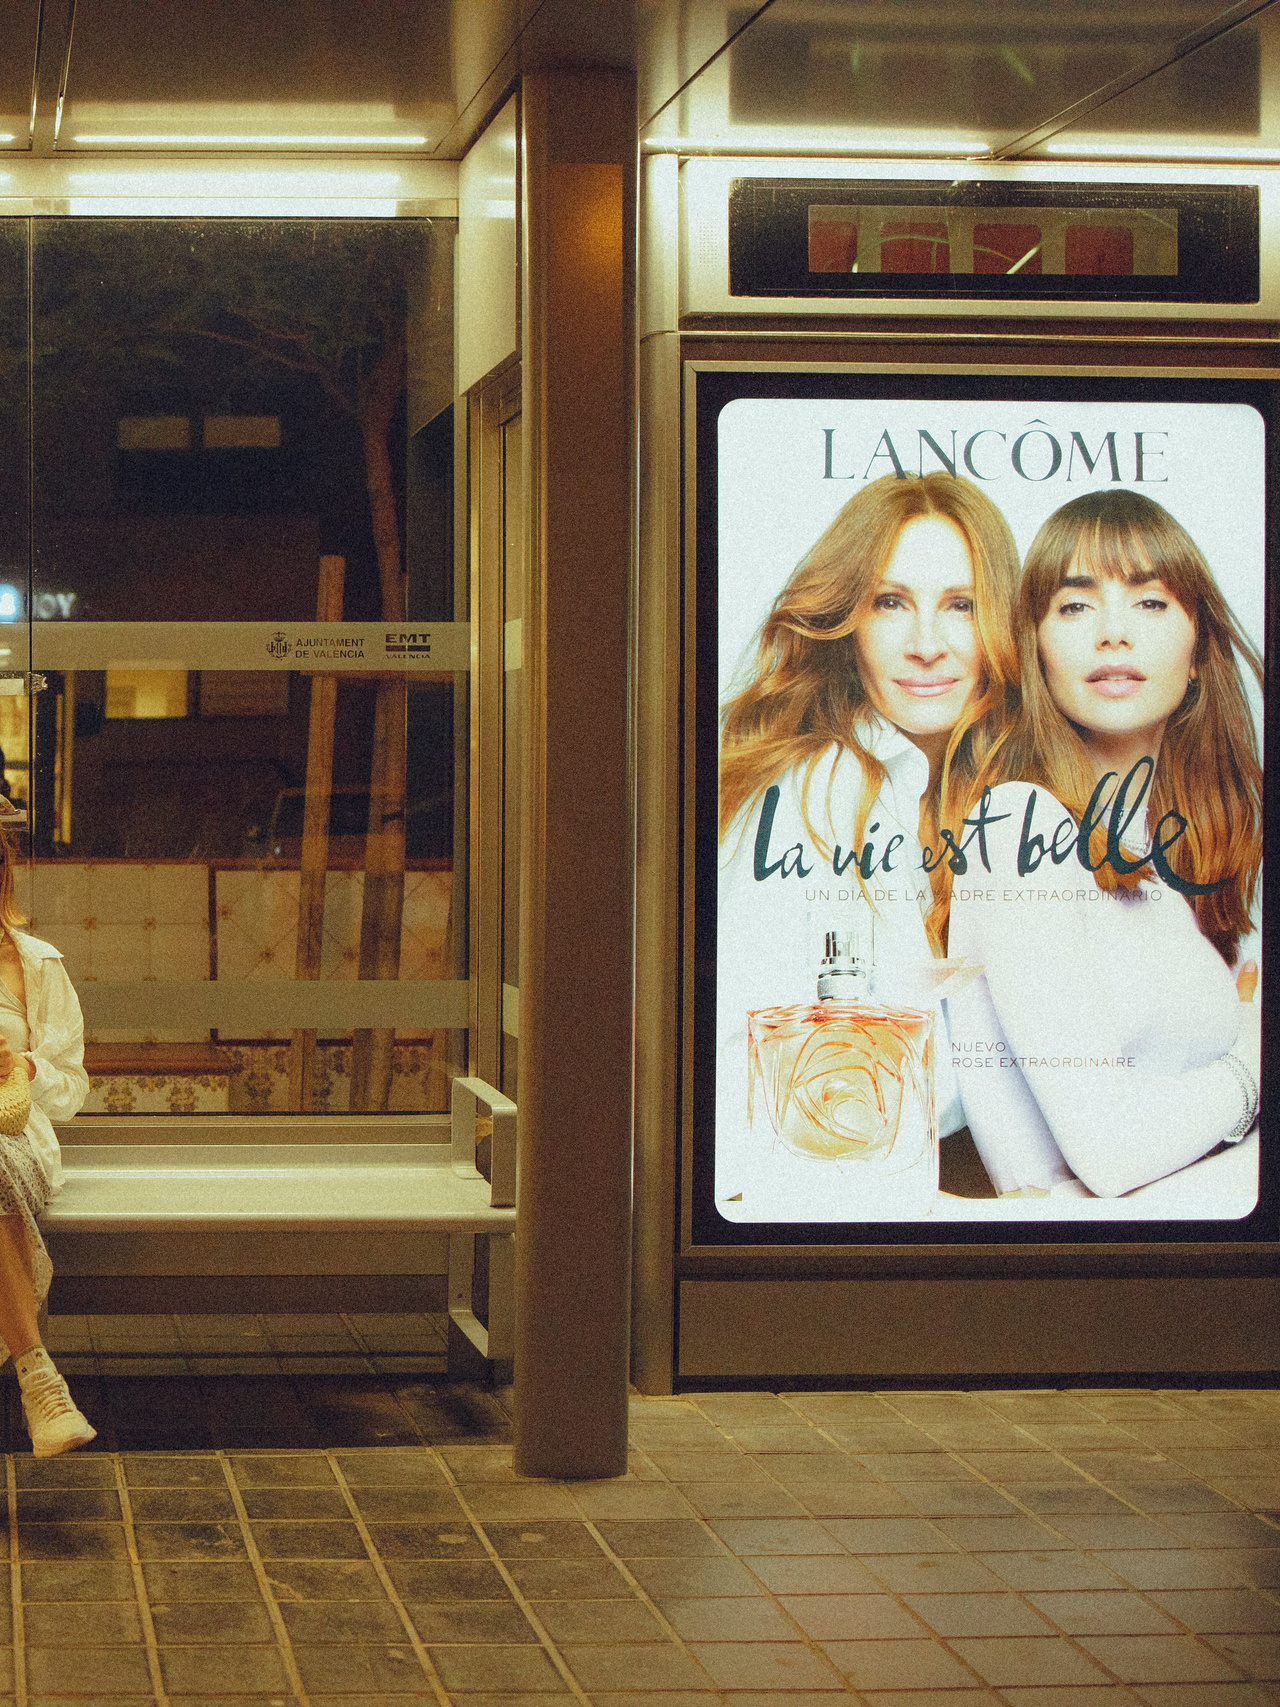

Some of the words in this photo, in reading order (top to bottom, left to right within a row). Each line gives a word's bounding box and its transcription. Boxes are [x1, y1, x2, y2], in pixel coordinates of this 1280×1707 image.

[821, 418, 1170, 484] LANCÔME
[296, 638, 366, 647] AJUNTAMENT
[385, 633, 431, 643] EMT
[295, 650, 310, 659] DE
[753, 784, 815, 882] La
[832, 821, 905, 880] vie
[916, 784, 1012, 876] est
[1017, 755, 1230, 897] belle
[804, 889, 831, 902] UN
[874, 889, 898, 902] DE
[905, 889, 927, 902] LA
[1003, 889, 1163, 902] EXTRAORDINARIO
[951, 1041, 1007, 1053] NUEVO
[951, 1057, 994, 1069] ROSE
[999, 1057, 1137, 1068] EXTRAORDINAIRE
